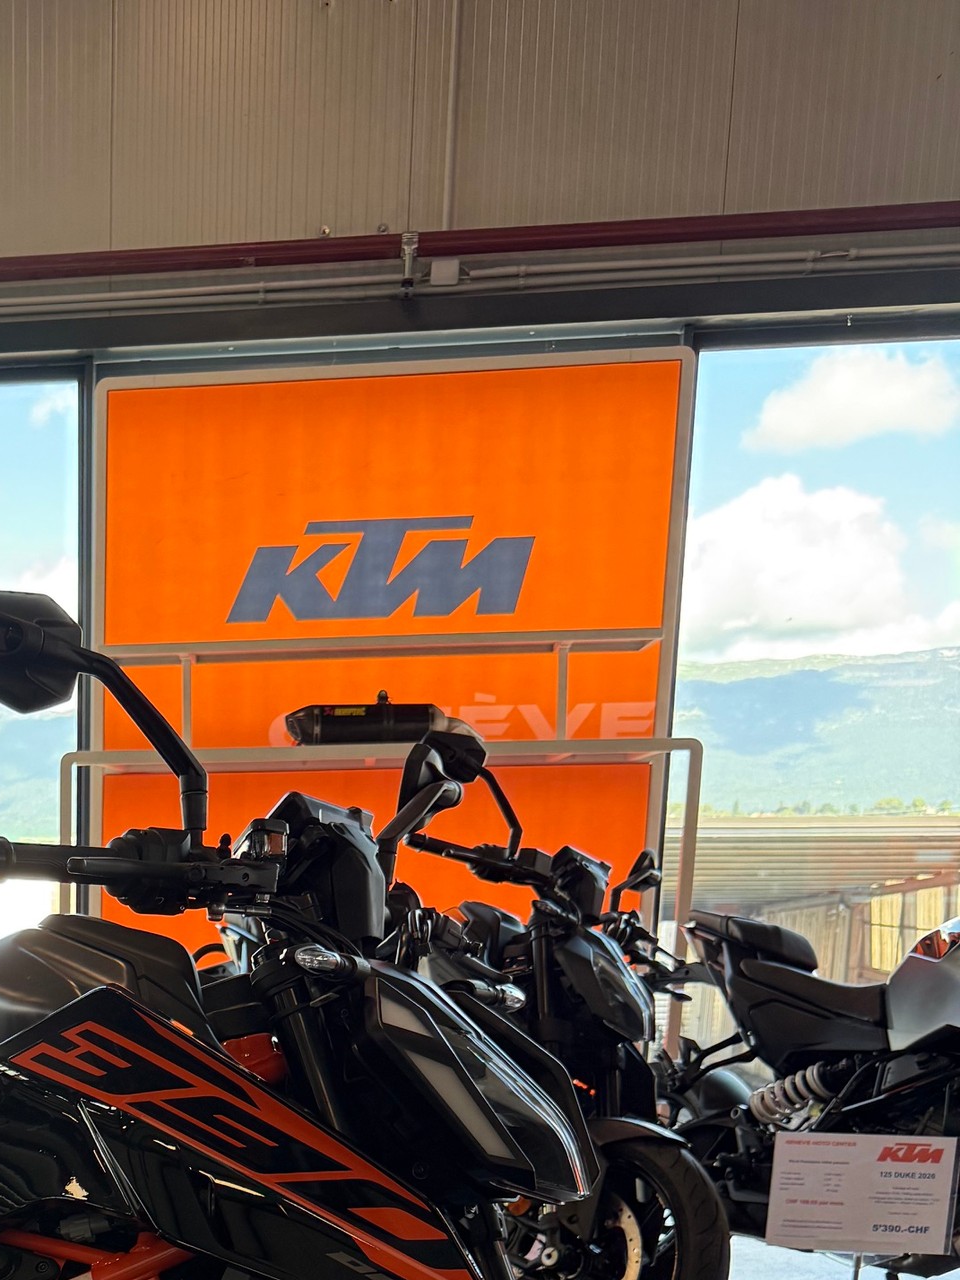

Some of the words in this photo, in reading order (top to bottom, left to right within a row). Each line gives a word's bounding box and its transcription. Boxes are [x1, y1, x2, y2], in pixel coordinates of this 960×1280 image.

[226, 515, 536, 624] KTM
[876, 1142, 945, 1164] KTM
[880, 1171, 893, 1179] 125
[894, 1171, 916, 1180] DUKE
[872, 1224, 930, 1234] 5'390.-CHF
